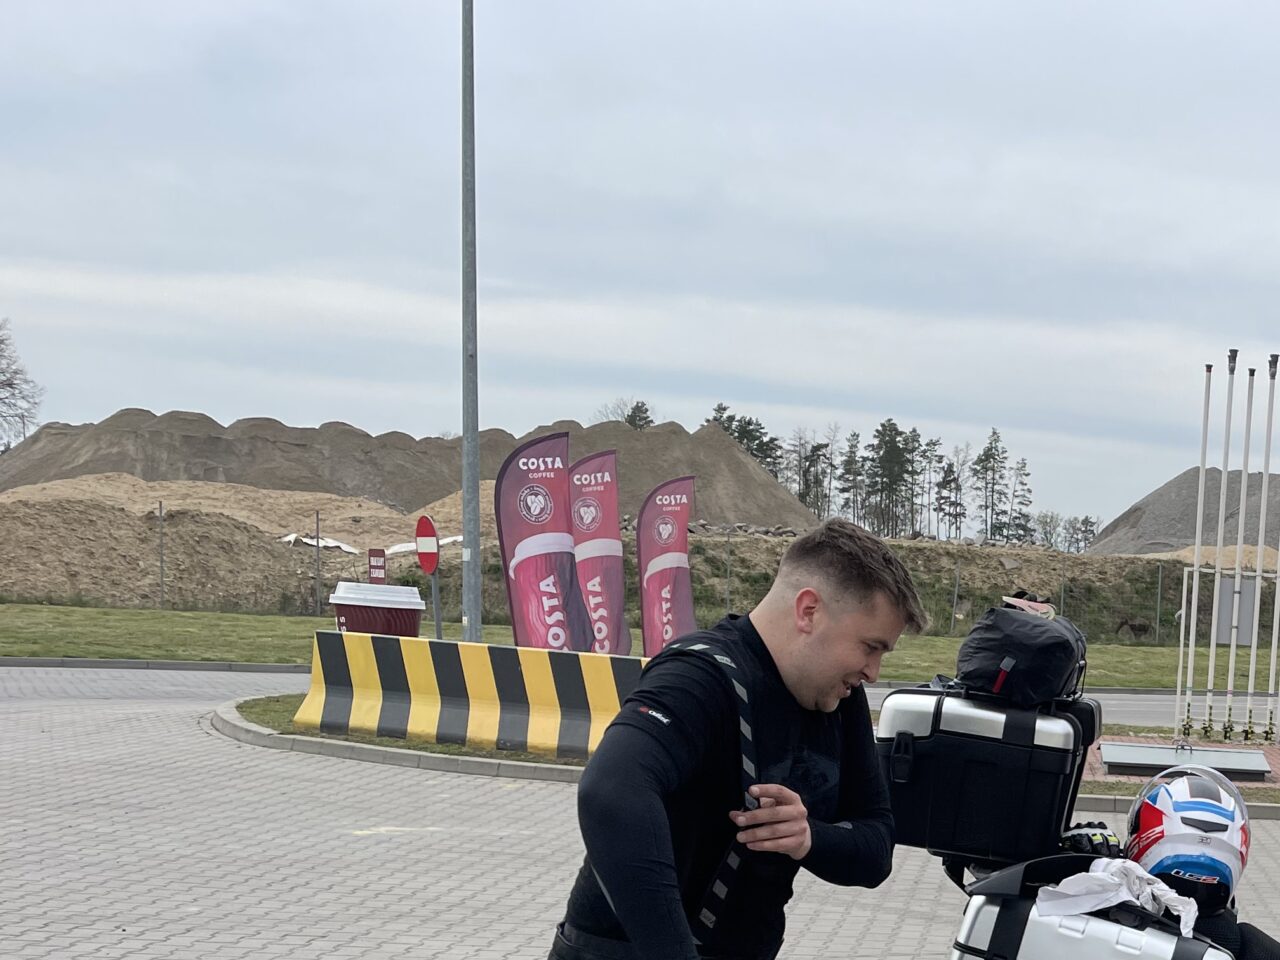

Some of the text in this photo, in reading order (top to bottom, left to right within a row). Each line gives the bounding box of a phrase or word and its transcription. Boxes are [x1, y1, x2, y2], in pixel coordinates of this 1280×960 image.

[518, 456, 564, 471] COSTA
[528, 471, 555, 479] COFFEE
[573, 471, 611, 486] COSTA
[655, 494, 688, 506] COSTA
[539, 574, 568, 651] OSTA
[586, 576, 610, 654] COSTA
[661, 584, 673, 648] OSTA
[1171, 868, 1220, 884] LS2
